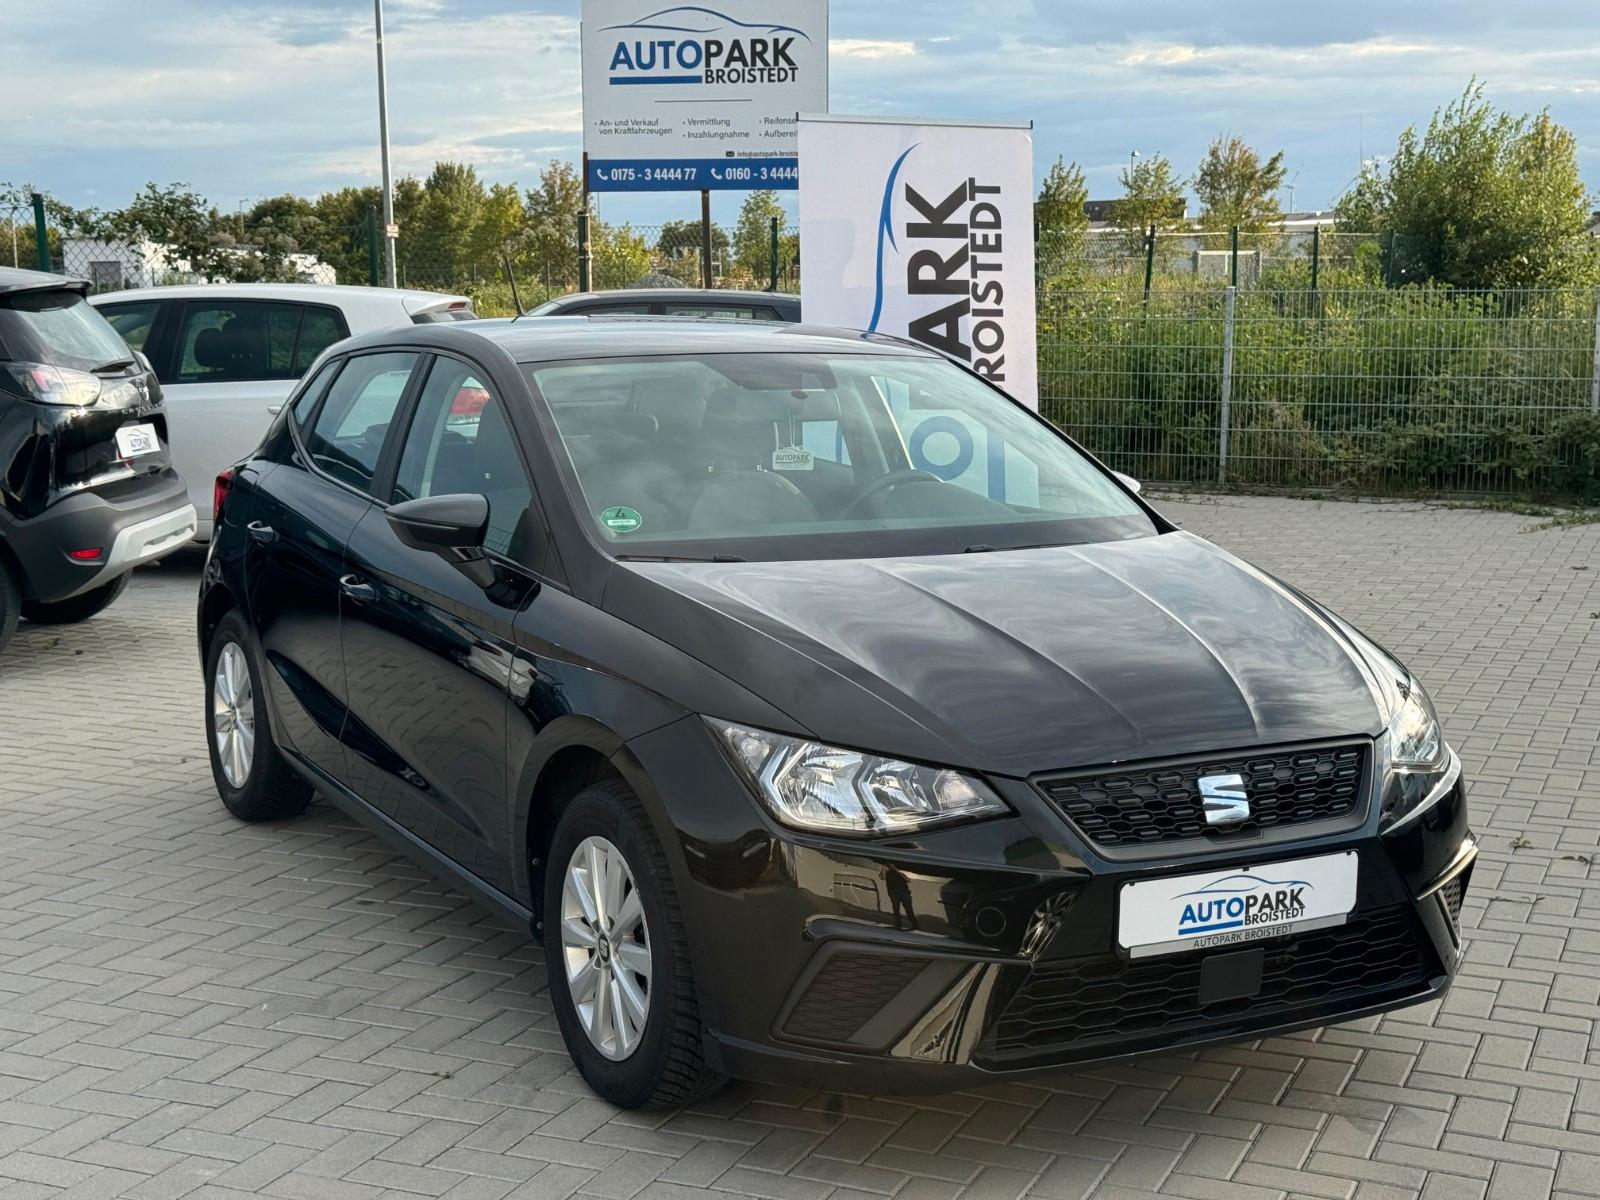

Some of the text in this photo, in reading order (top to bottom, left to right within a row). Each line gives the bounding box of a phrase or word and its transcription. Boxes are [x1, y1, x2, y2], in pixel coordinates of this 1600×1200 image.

[609, 38, 798, 71] AUTOPARK
[705, 67, 799, 84] BROISTEDT
[599, 119, 613, 127] An-
[630, 118, 659, 127] Verkauf
[687, 118, 731, 128] Vermittlung
[614, 126, 673, 137] Kraftfahrzeugen
[687, 130, 750, 140] Inzahlungnahme
[610, 167, 635, 181] 0175
[644, 167, 652, 181] 3
[725, 167, 751, 180] 0160
[760, 167, 768, 180] 3
[968, 177, 1005, 386] ROISTEDT
[1179, 887, 1305, 925] AUTOPARK
[1244, 907, 1306, 926] BROISTEDT
[1193, 925, 1293, 948] AUTOPARK BROISTEDT
